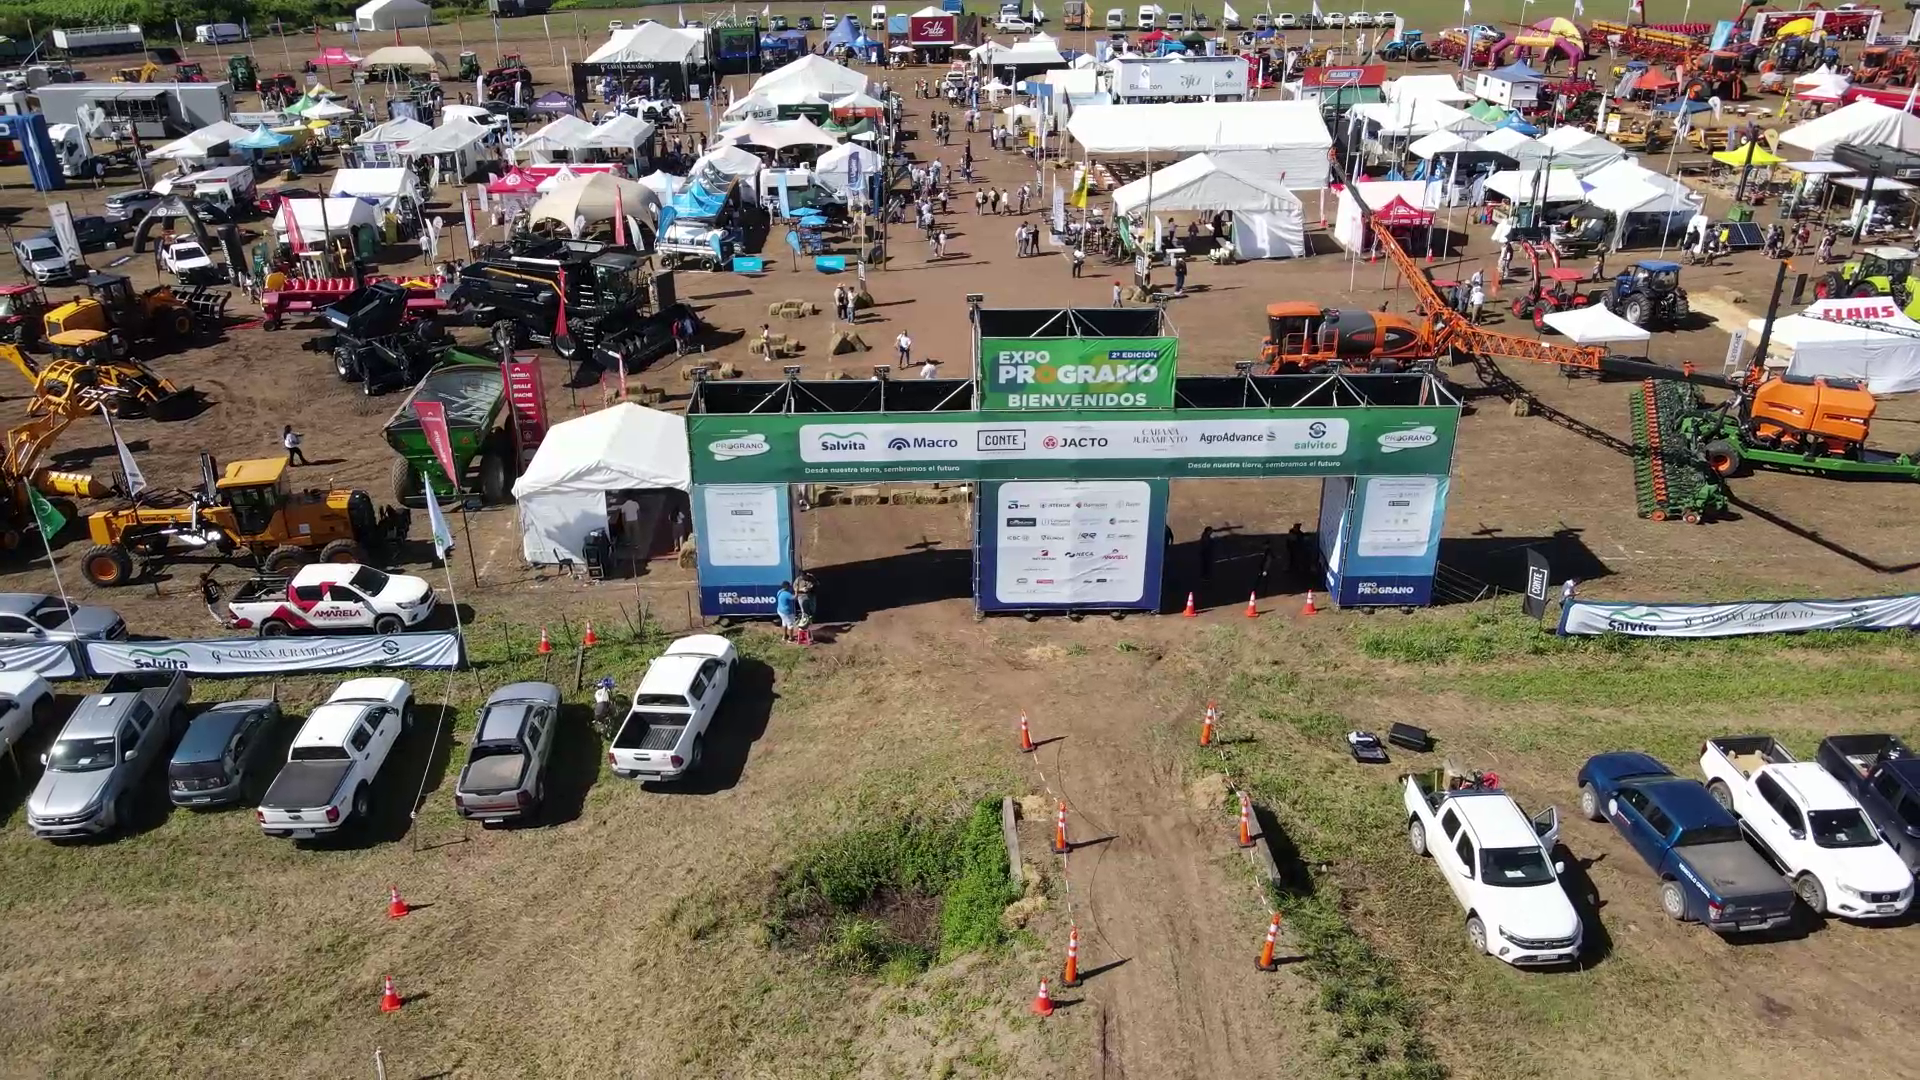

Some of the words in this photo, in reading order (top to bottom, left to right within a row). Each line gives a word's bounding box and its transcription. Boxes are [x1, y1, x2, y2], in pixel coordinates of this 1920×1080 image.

[1822, 306, 1895, 321] CLAAS
[998, 350, 1050, 364] EXPO
[1122, 351, 1157, 359] EDICIÓN
[998, 364, 1159, 384] PROGRANO
[1008, 393, 1148, 407] BIENVENIDOS
[913, 437, 958, 448] Macro
[985, 435, 1019, 446] CONTE
[1060, 438, 1108, 448] JACTO
[1200, 432, 1264, 443] AgroAdvance
[821, 440, 866, 451] Salvita
[1294, 440, 1338, 450] salvitec
[884, 465, 926, 473] sembramos
[936, 464, 960, 472] futuro
[1318, 460, 1341, 468] futuro
[1532, 572, 1543, 594] CONTE
[1358, 586, 1414, 594] PROGRANO
[719, 596, 776, 604] PROGRANO
[314, 610, 362, 618] AMARELA
[1608, 620, 1657, 632] Salvita
[278, 646, 345, 658] JURAMENTO
[133, 658, 188, 669] Salvita
